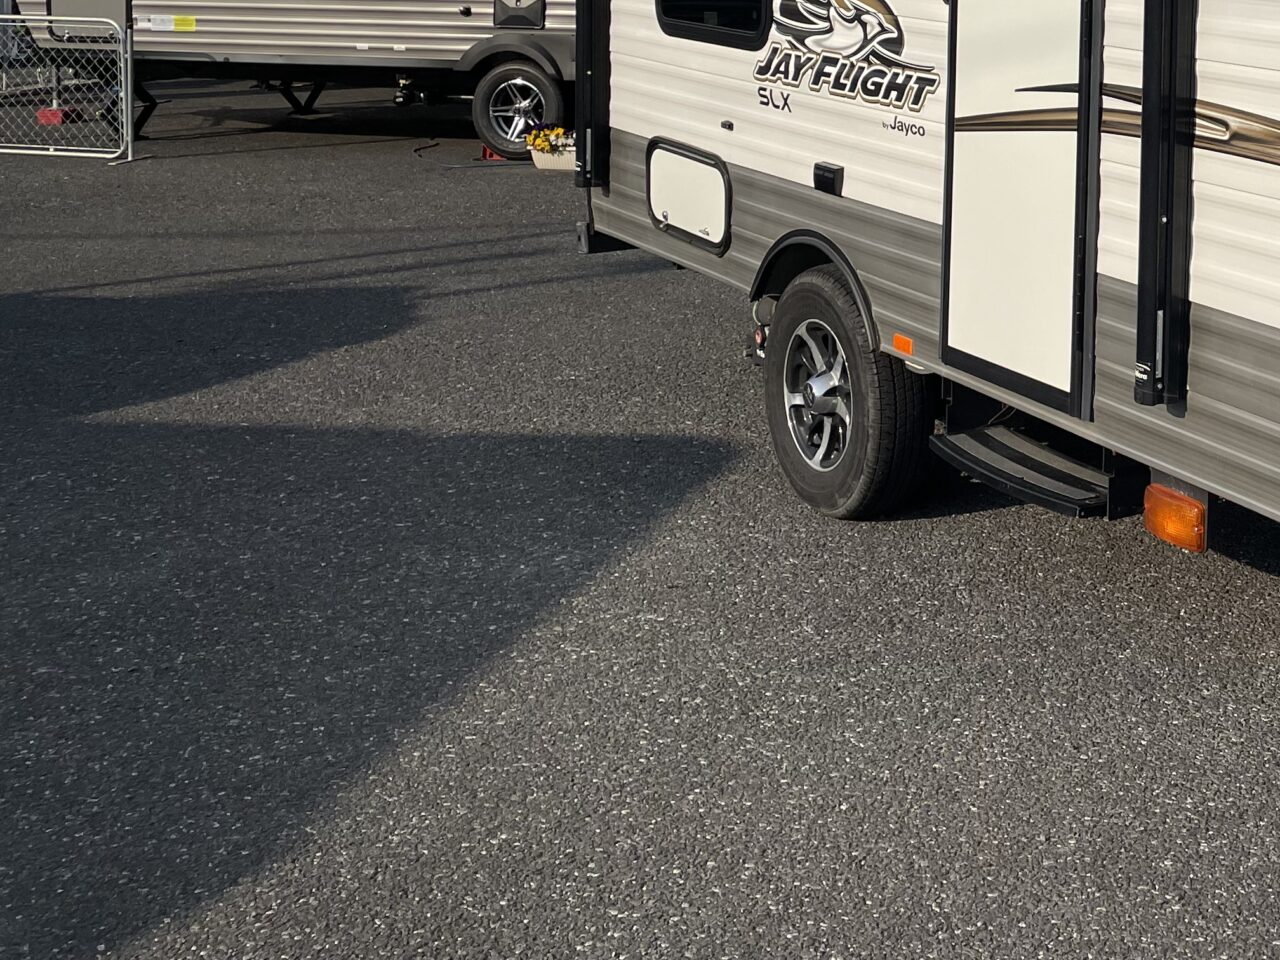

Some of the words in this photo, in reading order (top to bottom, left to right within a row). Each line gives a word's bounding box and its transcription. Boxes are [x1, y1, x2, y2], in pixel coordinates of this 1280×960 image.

[754, 42, 815, 87] JAY
[809, 50, 940, 112] FLIGHT
[758, 86, 792, 113] SLX
[890, 116, 926, 137] Jayco
